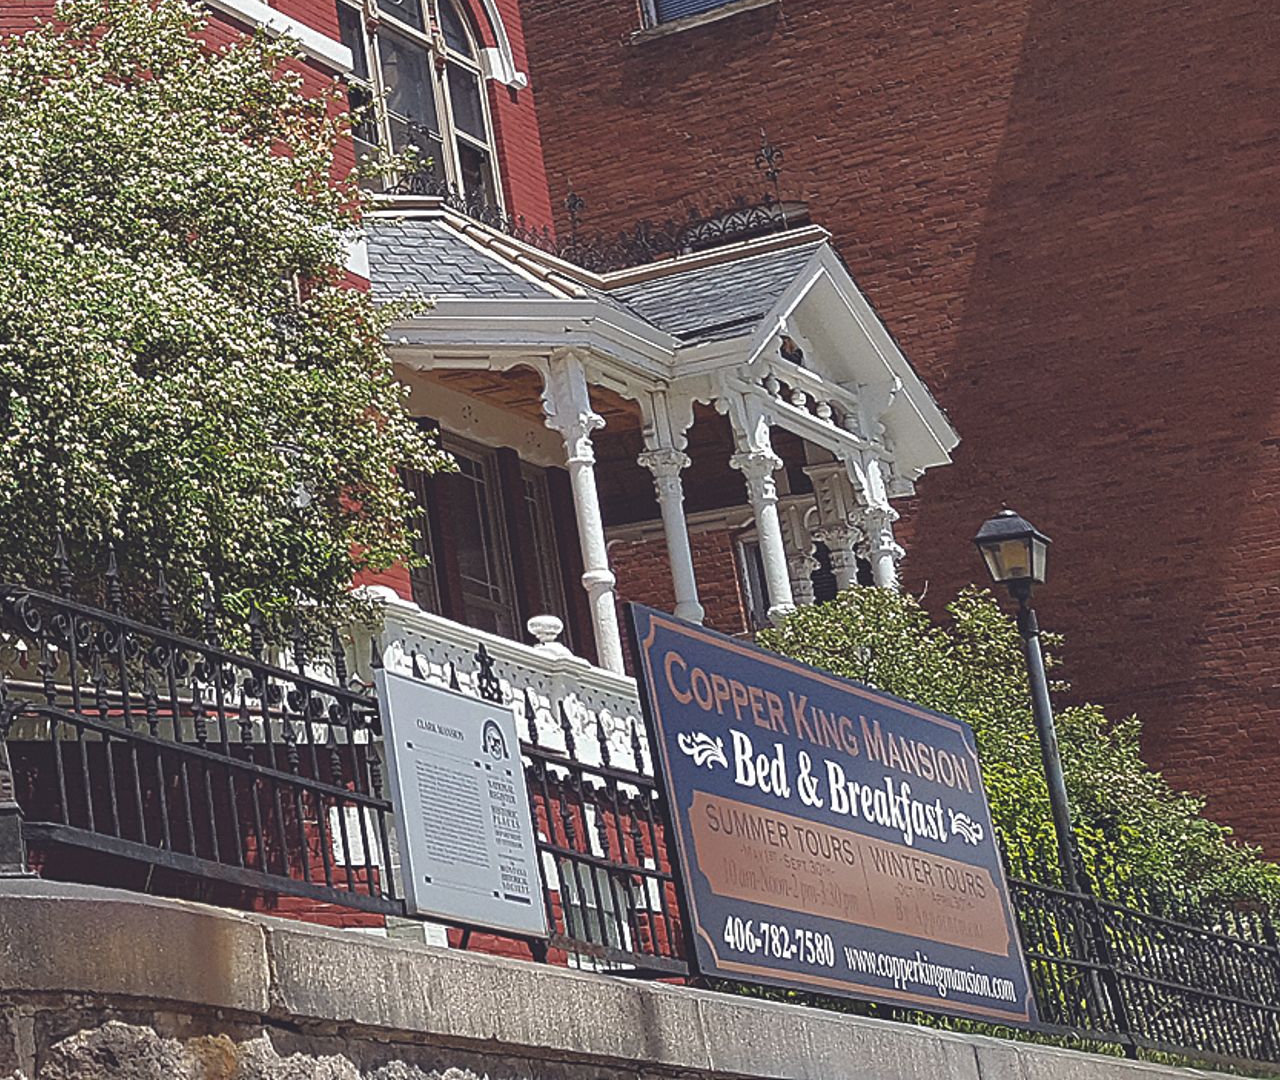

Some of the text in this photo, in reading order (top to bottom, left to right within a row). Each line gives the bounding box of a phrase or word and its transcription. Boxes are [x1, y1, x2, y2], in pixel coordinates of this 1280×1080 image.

[664, 651, 974, 794] COPPER KING MANSION
[729, 728, 949, 846] Bed & Breakfast
[705, 803, 855, 866] SUMMER TOURS
[868, 845, 936, 887] WINTER
[935, 863, 986, 899] TOURS
[723, 915, 1018, 1003] 406-782-7580 www.copperkingmansion.com
